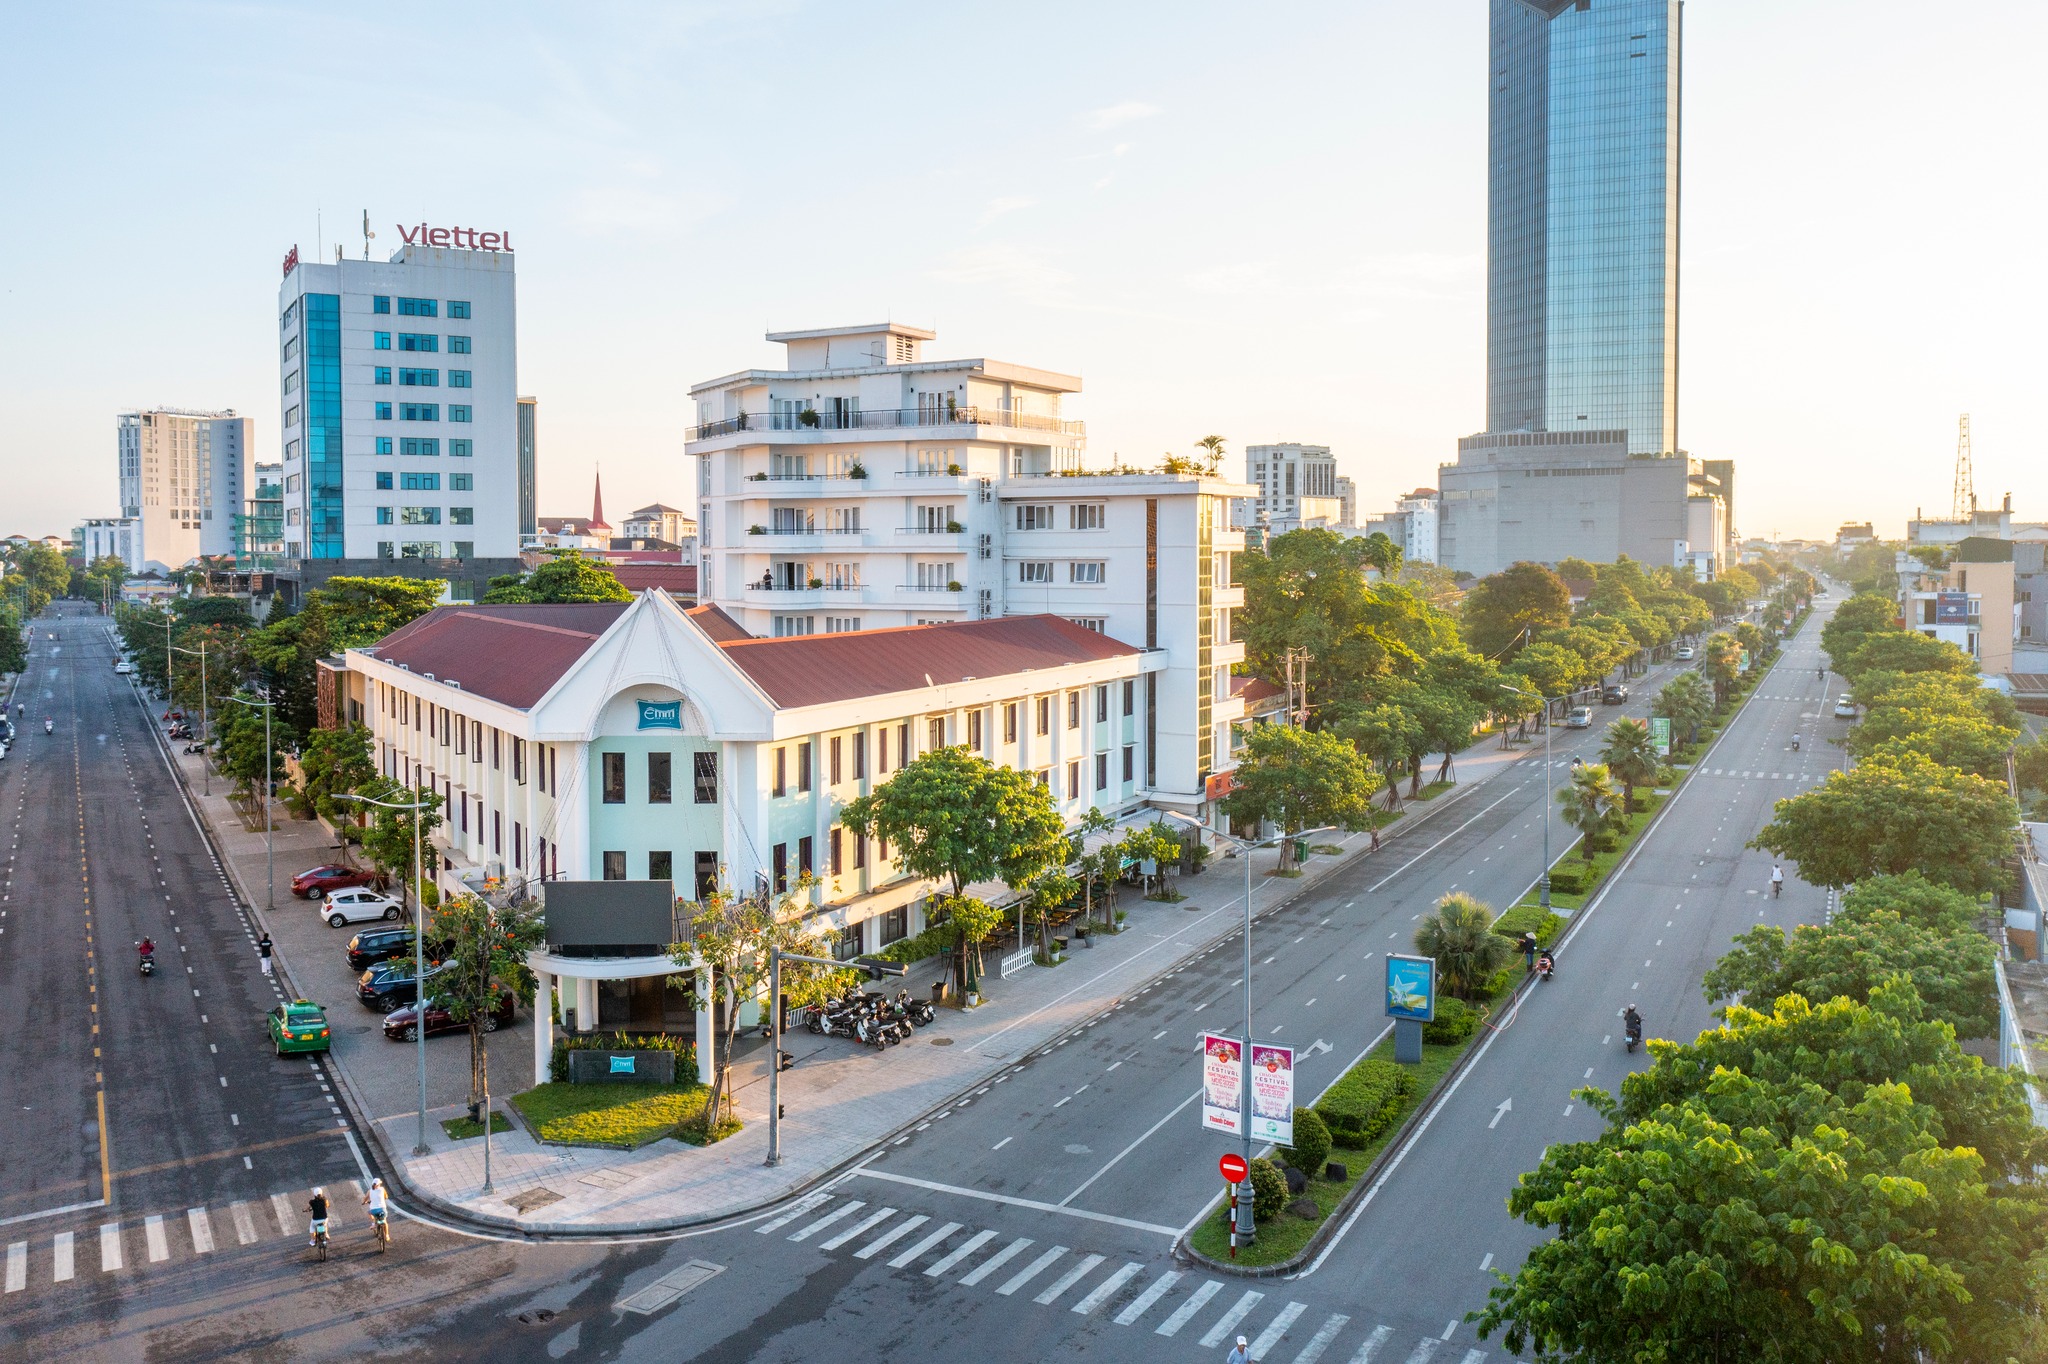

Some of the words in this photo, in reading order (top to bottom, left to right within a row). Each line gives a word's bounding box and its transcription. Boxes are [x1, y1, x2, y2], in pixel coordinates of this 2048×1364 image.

[396, 222, 514, 252] viettel
[1207, 1066, 1239, 1077] FESTIVAL
[1254, 1076, 1289, 1086] FESTIVAL
